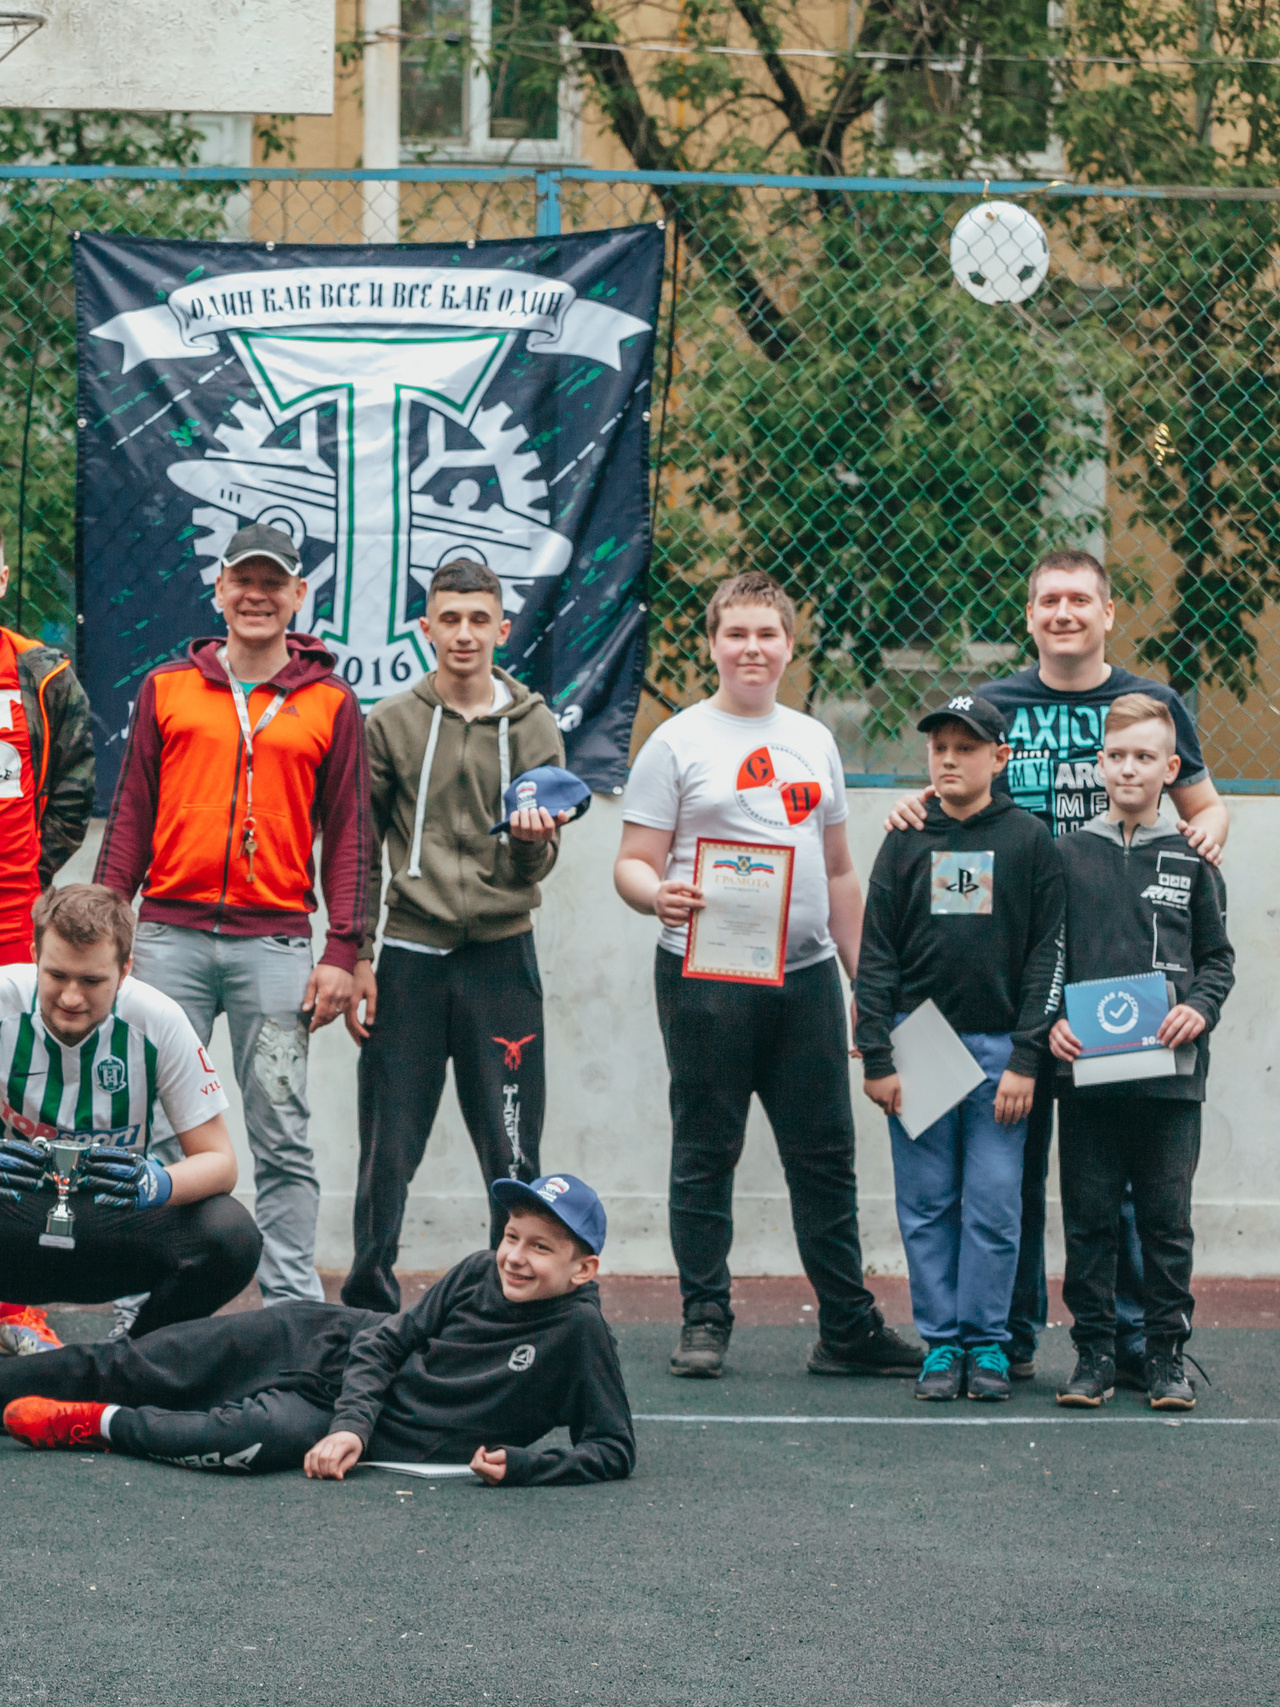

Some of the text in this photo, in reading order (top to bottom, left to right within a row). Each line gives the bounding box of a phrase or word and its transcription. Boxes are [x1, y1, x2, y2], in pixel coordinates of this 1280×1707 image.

[190, 289, 254, 322] ОДИН
[261, 285, 311, 313] КАК
[369, 282, 383, 308] И
[440, 284, 492, 312] КАК
[498, 288, 566, 319] ОДИН
[714, 874, 770, 889] ГРАМОТА
